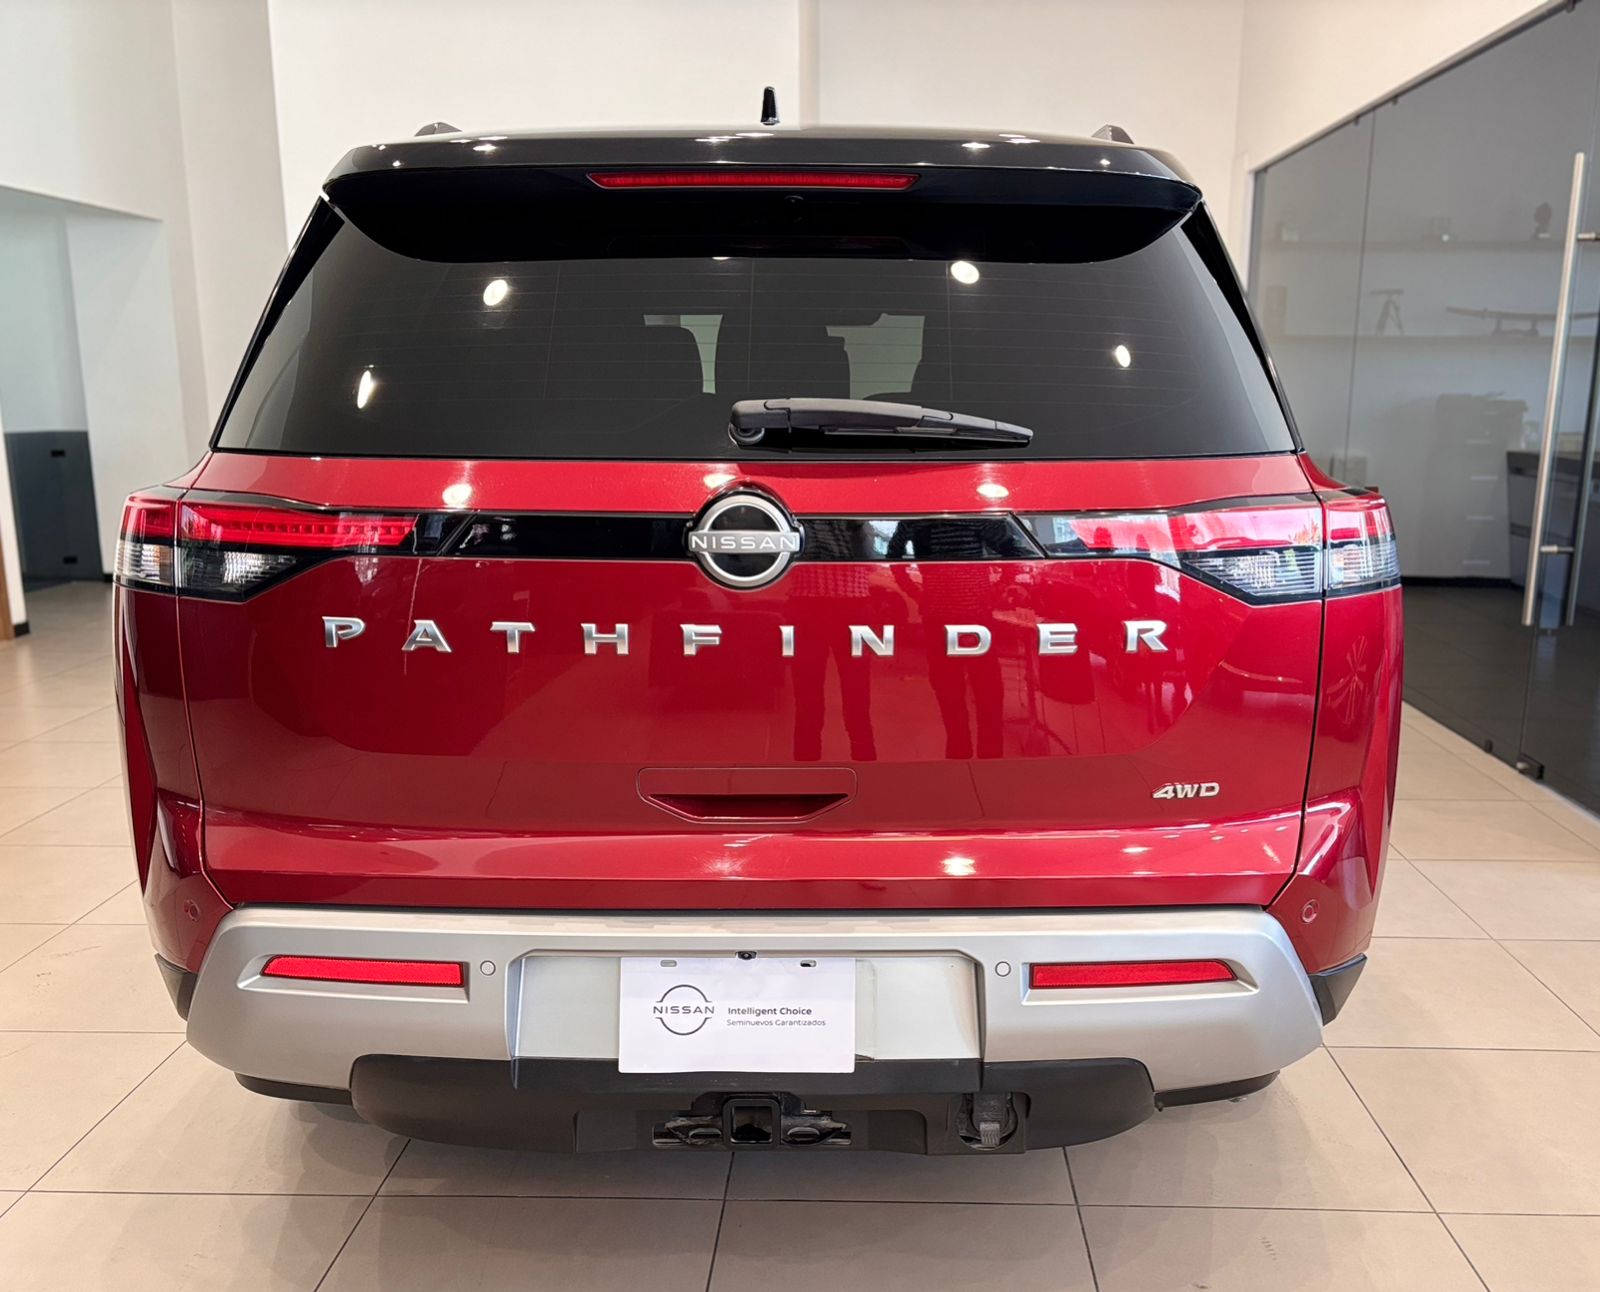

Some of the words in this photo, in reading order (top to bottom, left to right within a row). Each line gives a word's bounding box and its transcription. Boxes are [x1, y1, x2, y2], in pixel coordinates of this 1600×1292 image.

[691, 535, 797, 550] NISSAN
[321, 615, 1169, 657] PATHFINDER
[1152, 782, 1220, 799] 4WD
[653, 1005, 715, 1015] NISSAN
[727, 1007, 778, 1017] Intelligent
[779, 1007, 813, 1016] Choice
[726, 1019, 774, 1027] Seminuevos
[774, 1019, 827, 1027] Garantizados
